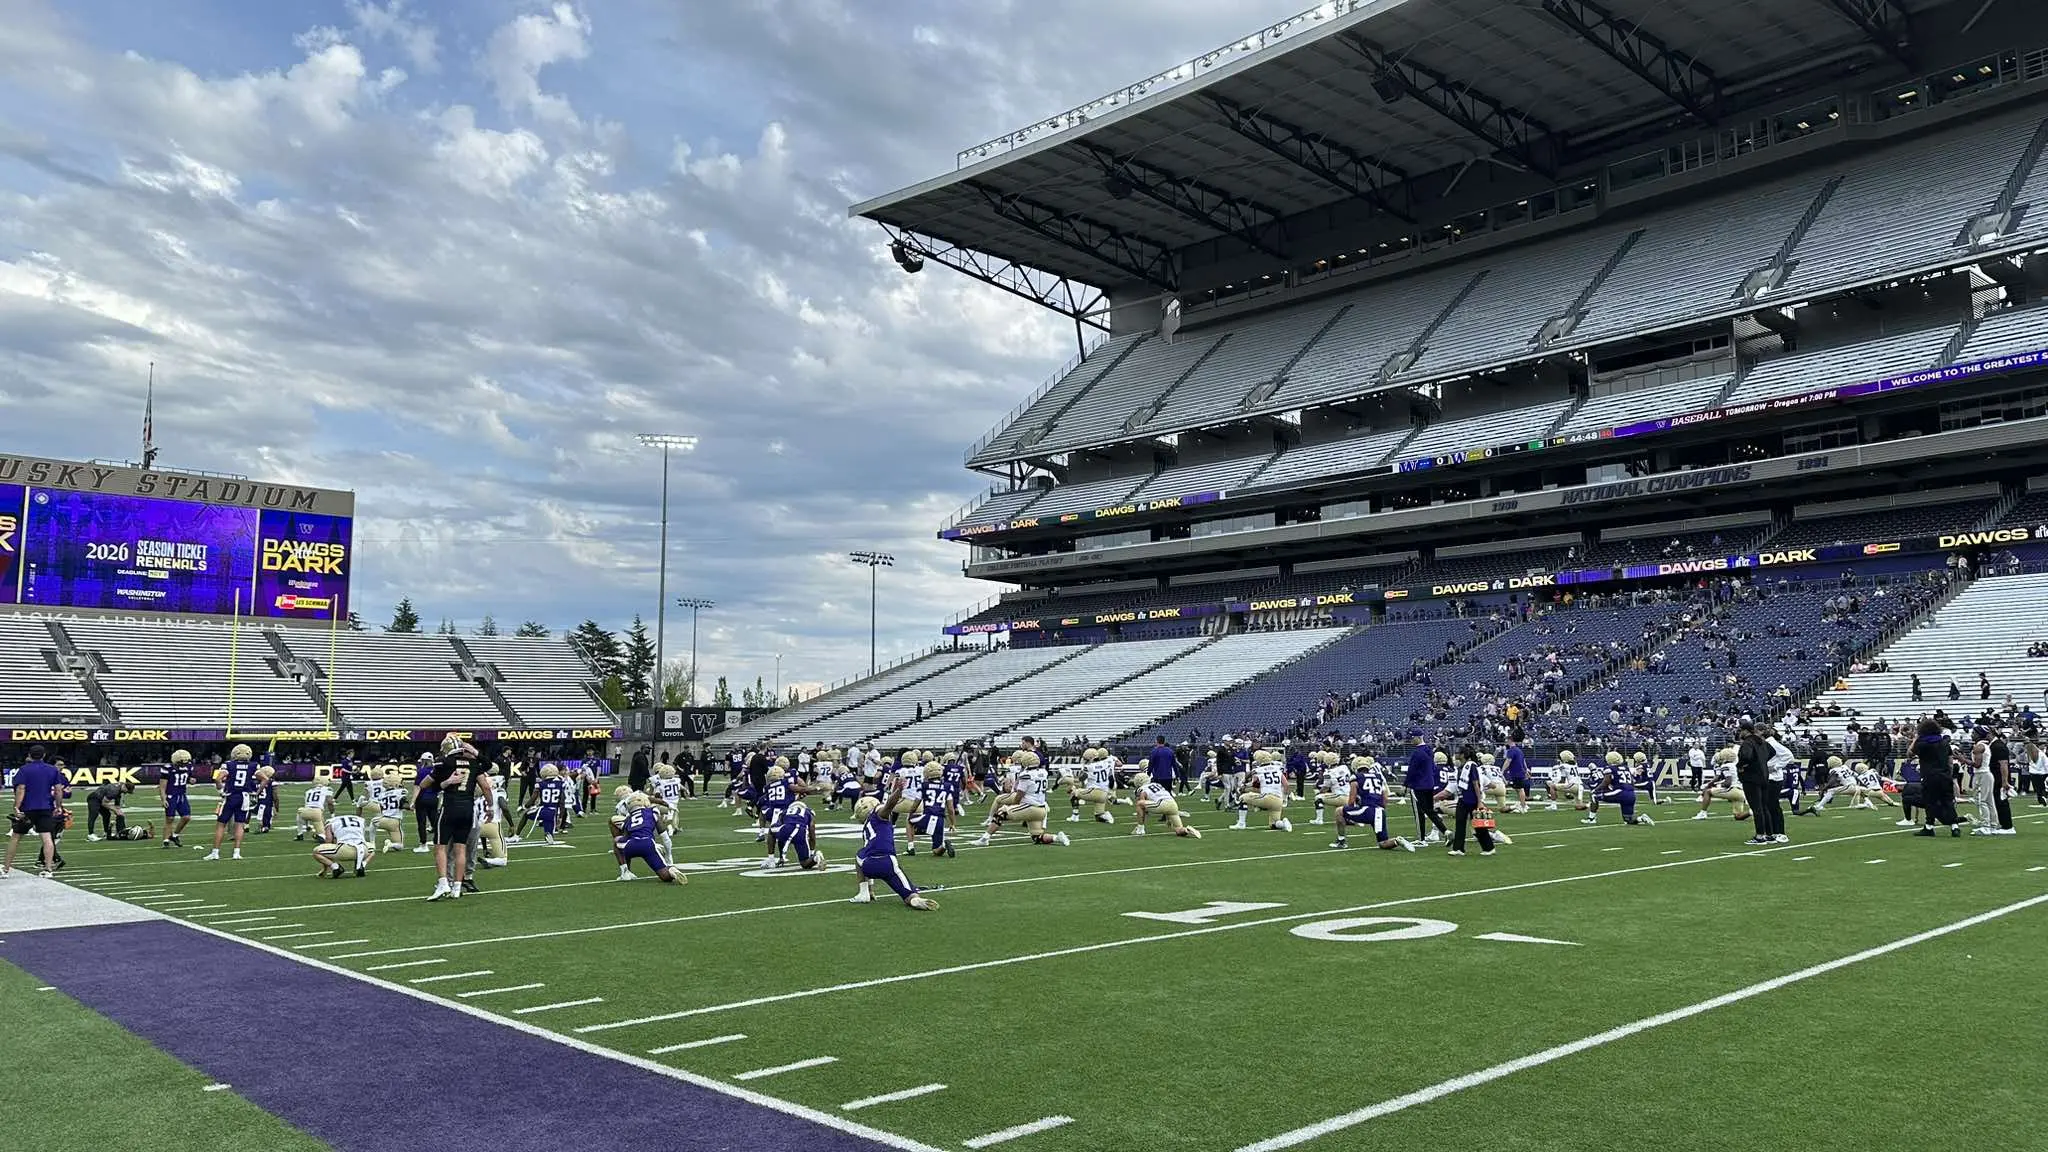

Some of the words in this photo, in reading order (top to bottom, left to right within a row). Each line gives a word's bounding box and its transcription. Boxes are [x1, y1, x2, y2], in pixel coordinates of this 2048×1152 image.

[1891, 371, 1942, 386] WELCOME
[1944, 368, 1958, 377] TO
[1960, 363, 1981, 374] THE
[1983, 354, 2038, 370] GREATEST
[1671, 411, 1721, 427] BASEBALL
[1726, 402, 1767, 416] TOMORROW
[1774, 398, 1798, 409] Oregon
[1809, 393, 1823, 403] 7:00
[1825, 390, 1837, 399] PM
[136, 473, 317, 510] STADIUM
[1560, 481, 1643, 504] NATIONAL
[1649, 464, 1751, 491] CHAMPIONS
[1095, 504, 1136, 518] DAWGS
[1150, 496, 1181, 510] DARK
[960, 524, 996, 536] DAWGS
[1010, 518, 1039, 529] DARK
[1938, 527, 2029, 548] DAWGS
[85, 542, 129, 561] 2026
[137, 540, 174, 557] SEASON
[177, 542, 208, 560] TICKET
[263, 538, 345, 557] DAWGS
[136, 555, 207, 571] RENEWALS
[262, 552, 344, 575] DARK
[1659, 558, 1728, 575] DAWGS
[1759, 548, 1817, 565] DARK
[1432, 581, 1489, 595] DAWGS
[1509, 574, 1555, 589] DARK
[117, 588, 166, 598] WASHINGTON
[1250, 598, 1296, 611] DAWGS
[1316, 592, 1354, 605] DARK
[1096, 612, 1135, 623] DAWGS
[1149, 607, 1181, 619] DARK
[962, 623, 997, 633] DAWGS
[1012, 619, 1040, 629] DARK
[690, 714, 716, 733] W
[12, 729, 88, 741] DAWGS
[114, 730, 169, 741] DARK
[276, 730, 340, 741] DAWGS
[366, 730, 411, 741] DARK
[498, 730, 553, 740] DAWGS
[572, 729, 612, 739] DARK
[174, 772, 188, 786] 10
[234, 770, 247, 787] 9
[947, 772, 960, 782] 77
[1093, 769, 1108, 783] 70
[1264, 772, 1281, 784] 55
[1618, 770, 1631, 784] 33
[1792, 772, 1799, 785] 3
[1862, 774, 1877, 787] 24
[373, 787, 381, 798] 2
[664, 785, 679, 798] 20
[768, 786, 785, 801] 29
[1035, 780, 1047, 794] 79
[1362, 777, 1383, 795] 45
[306, 790, 320, 803] 16
[382, 795, 398, 810] 35
[541, 788, 560, 803] 82
[925, 789, 947, 808] 34
[340, 816, 361, 828] 15
[631, 813, 643, 827] 5
[1120, 900, 1459, 943] 10
